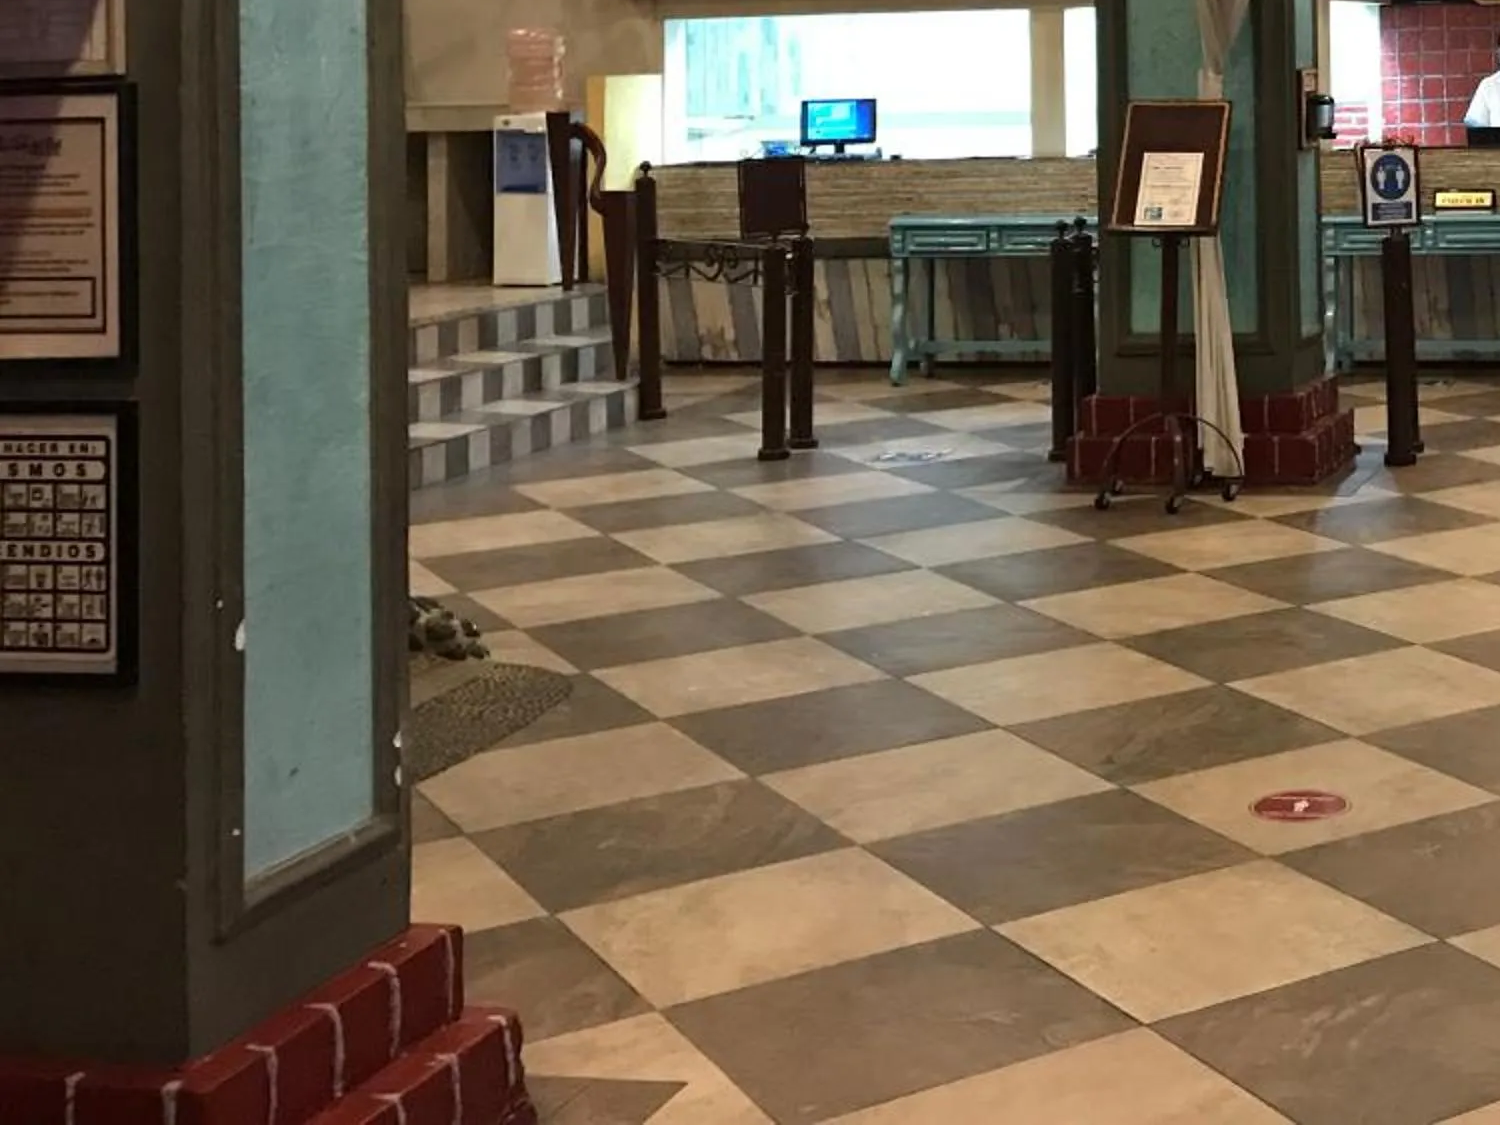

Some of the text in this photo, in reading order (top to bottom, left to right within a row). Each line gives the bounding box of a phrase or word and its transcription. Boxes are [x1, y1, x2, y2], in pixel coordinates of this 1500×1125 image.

[4, 442, 58, 454] HACER
[8, 463, 87, 477] SMOS
[0, 544, 96, 559] ENDIOS
